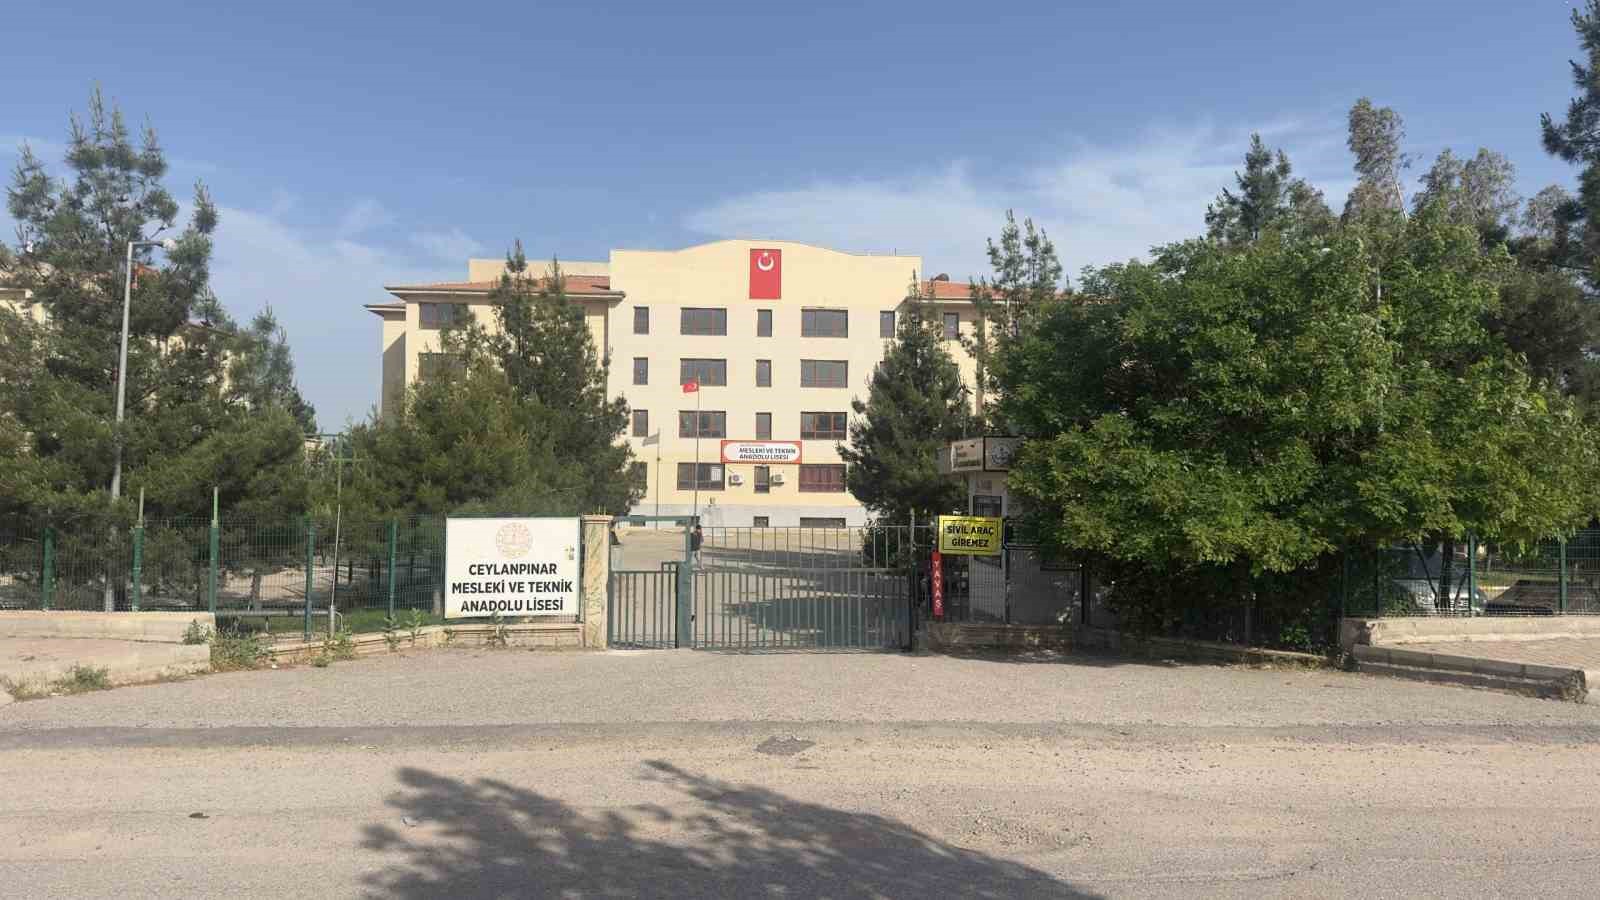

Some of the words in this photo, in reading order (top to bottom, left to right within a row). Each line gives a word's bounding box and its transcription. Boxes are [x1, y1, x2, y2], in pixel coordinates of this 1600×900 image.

[947, 524, 969, 534] SİVİL
[970, 526, 994, 536] ARAÇ
[951, 537, 989, 547] GİREMEZ
[468, 563, 557, 575] CEYLANPINAR
[452, 580, 505, 594] MESLEKİ
[508, 581, 525, 593] VE
[528, 579, 573, 592] TEKNİK
[461, 600, 523, 612] ANADOLU
[526, 597, 563, 611] LİSESİ
